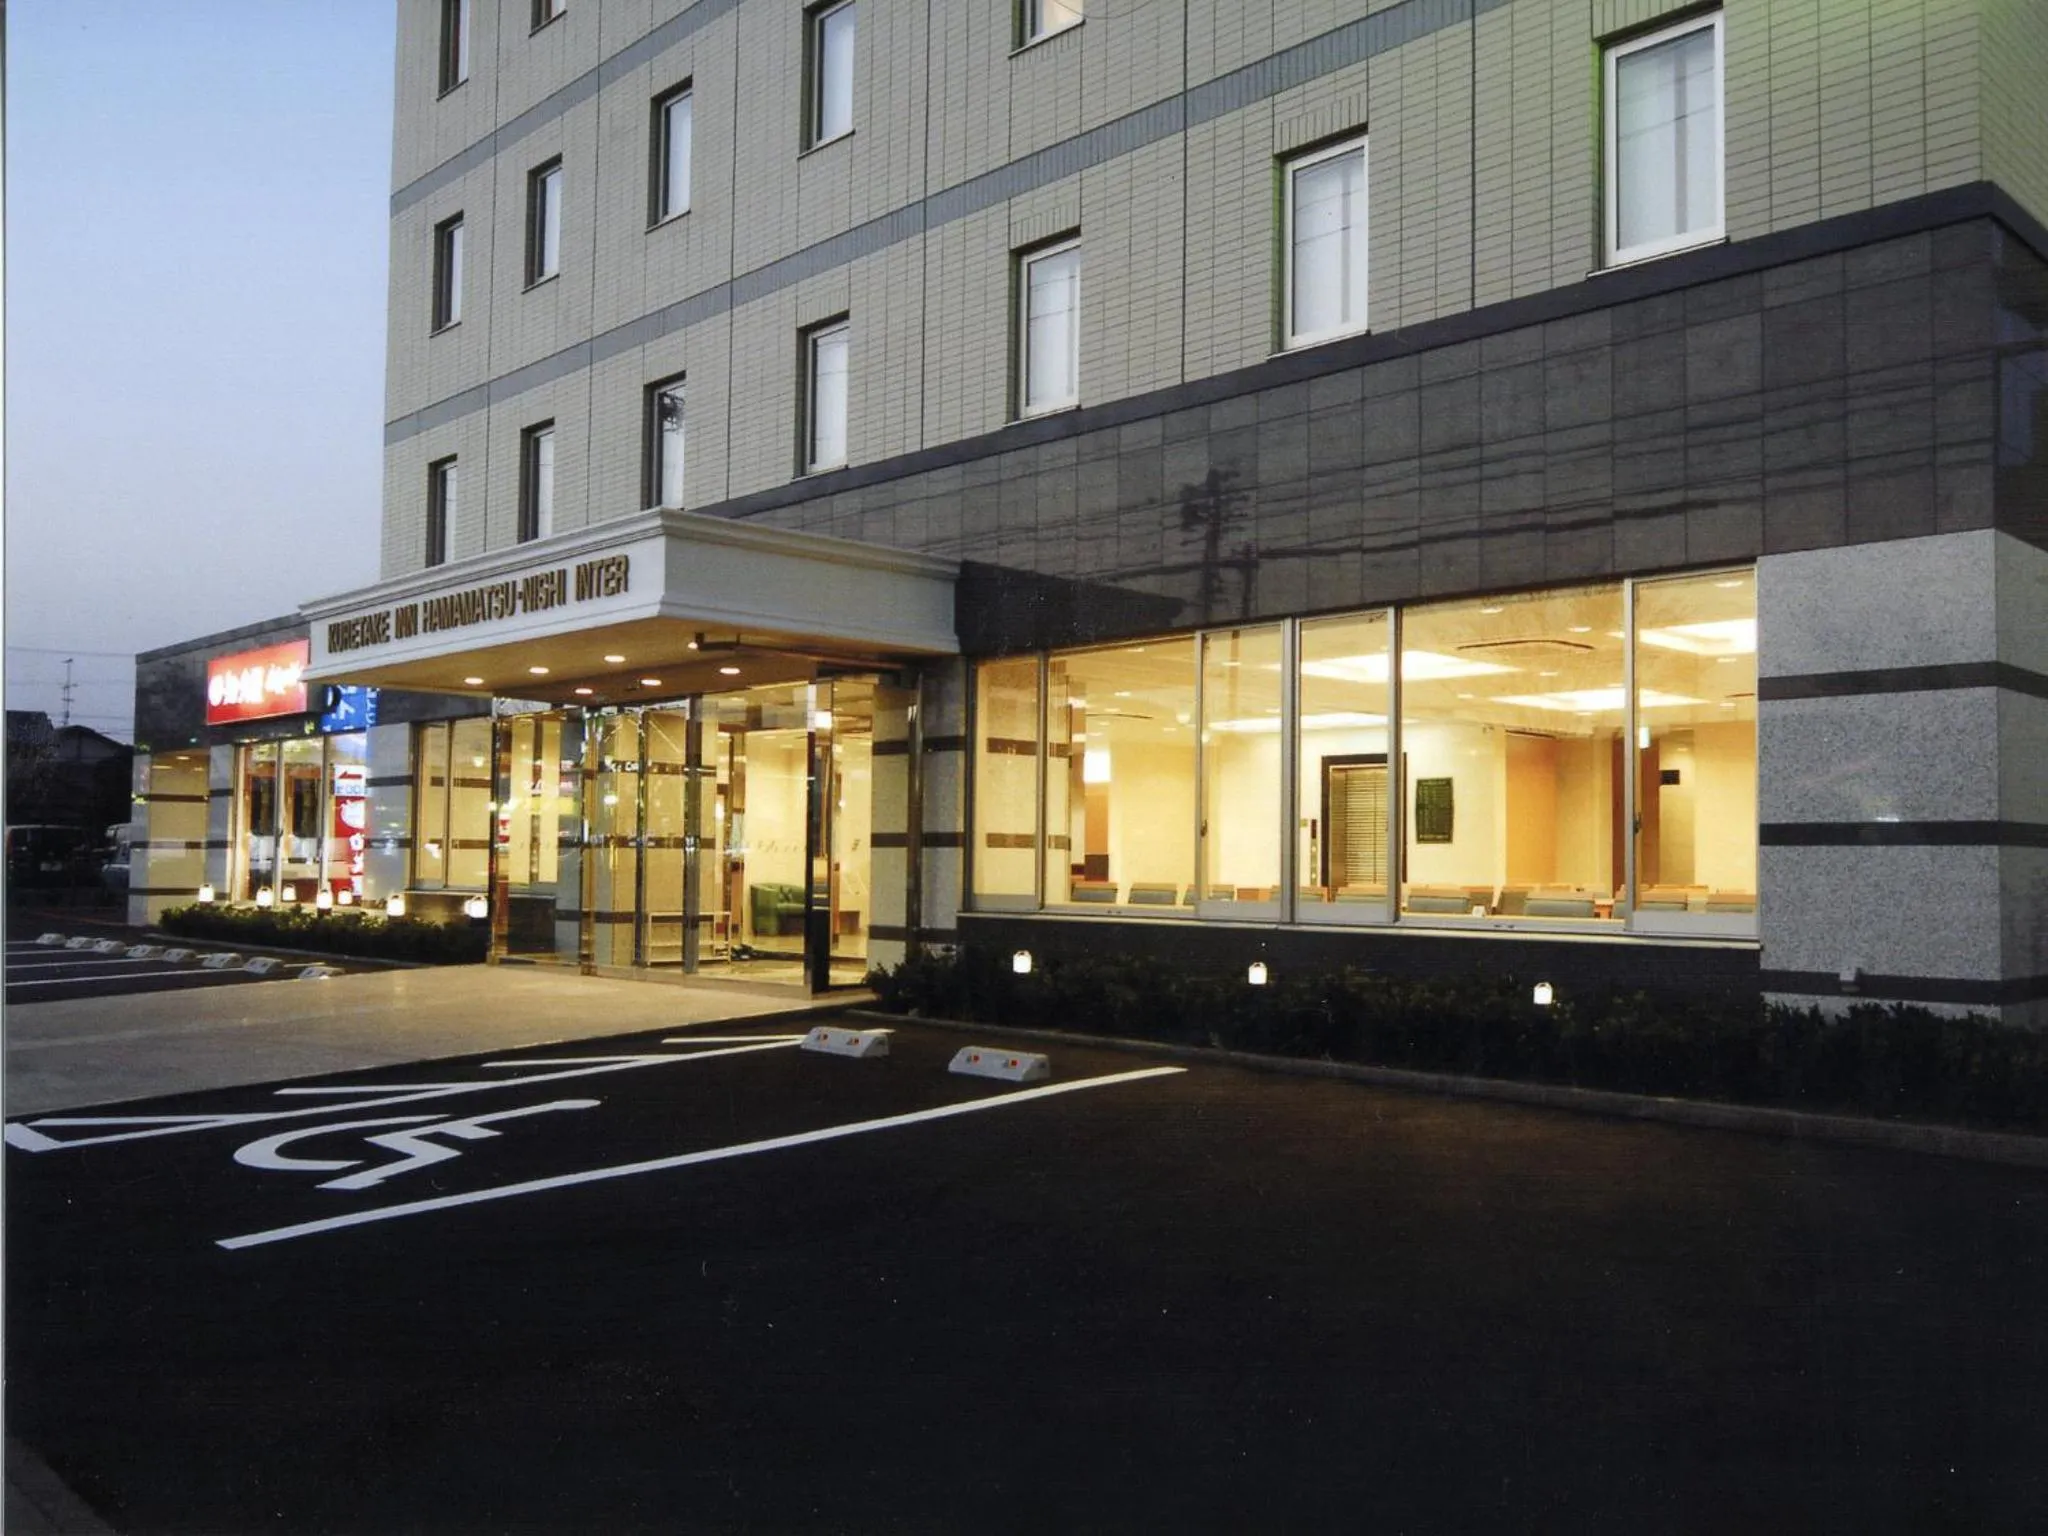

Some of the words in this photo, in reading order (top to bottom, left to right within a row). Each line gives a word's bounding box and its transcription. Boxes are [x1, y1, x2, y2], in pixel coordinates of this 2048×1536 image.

[328, 611, 390, 653] KURETAKE
[395, 603, 418, 640] INN
[423, 568, 567, 633] HAMAMATSU-NISHI
[576, 554, 630, 601] INTER
